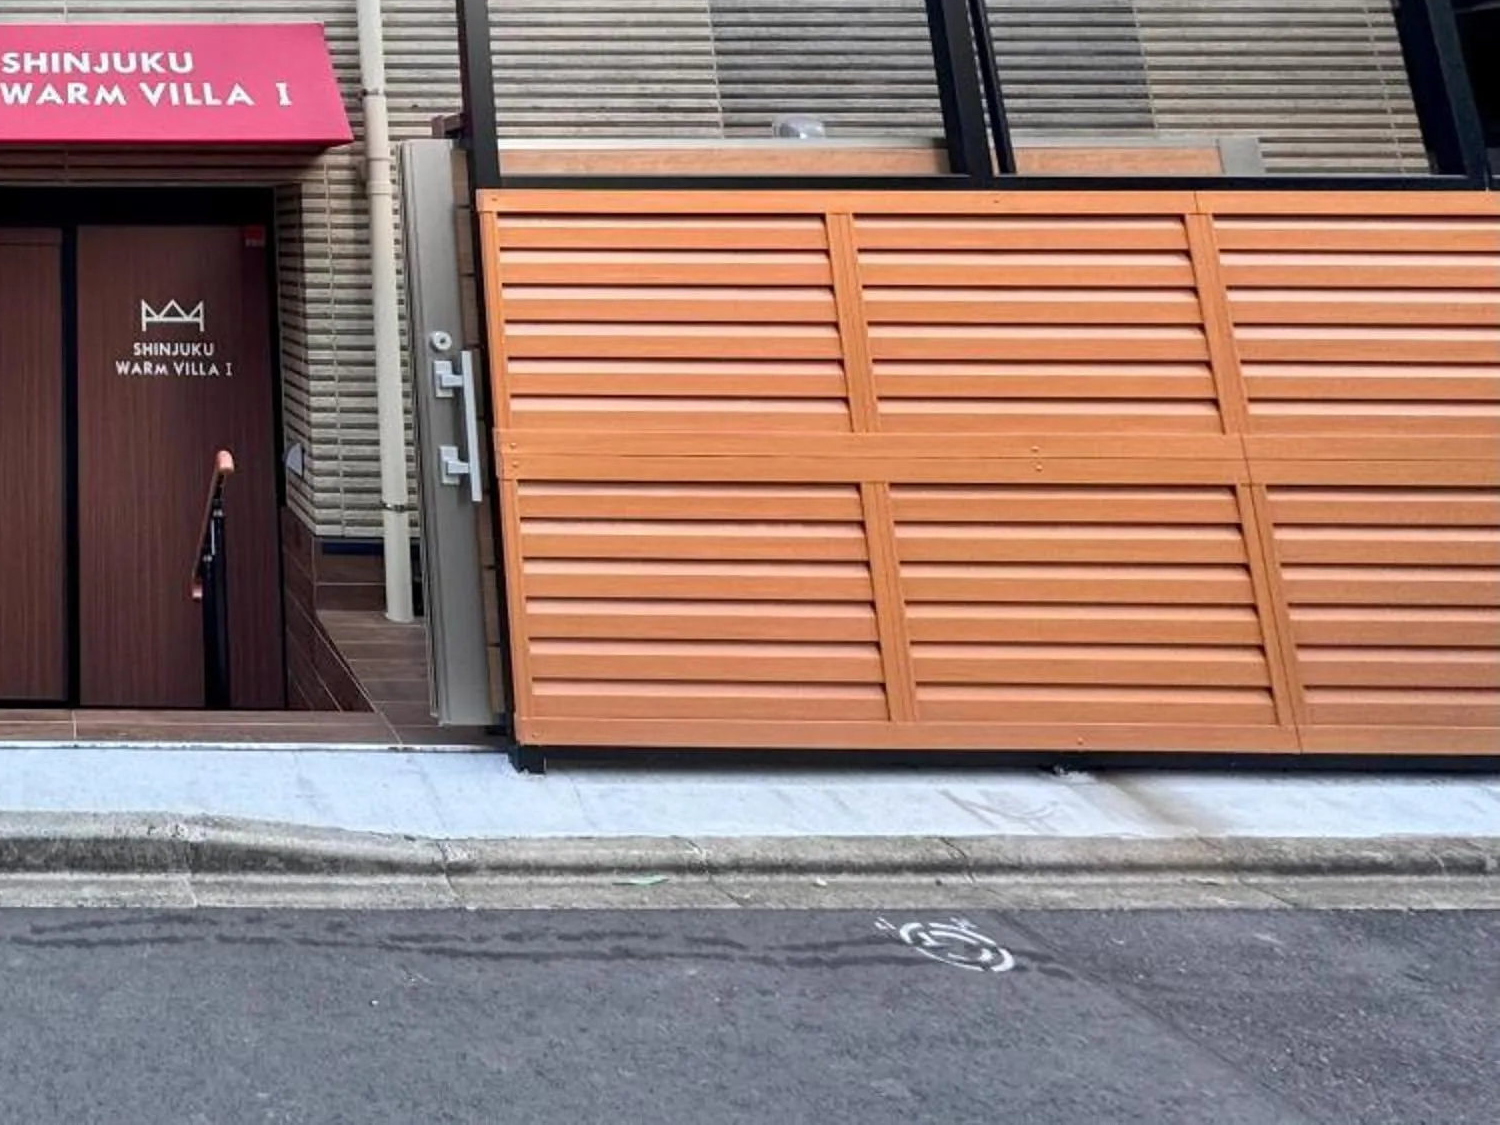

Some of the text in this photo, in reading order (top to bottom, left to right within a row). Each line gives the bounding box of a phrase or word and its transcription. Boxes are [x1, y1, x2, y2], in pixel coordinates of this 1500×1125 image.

[1, 51, 194, 74] SHINJUKU
[0, 82, 293, 106] WARM VILLA I
[133, 342, 214, 356] SHINJUKU
[115, 360, 169, 376] WARM
[173, 361, 219, 376] VILLA
